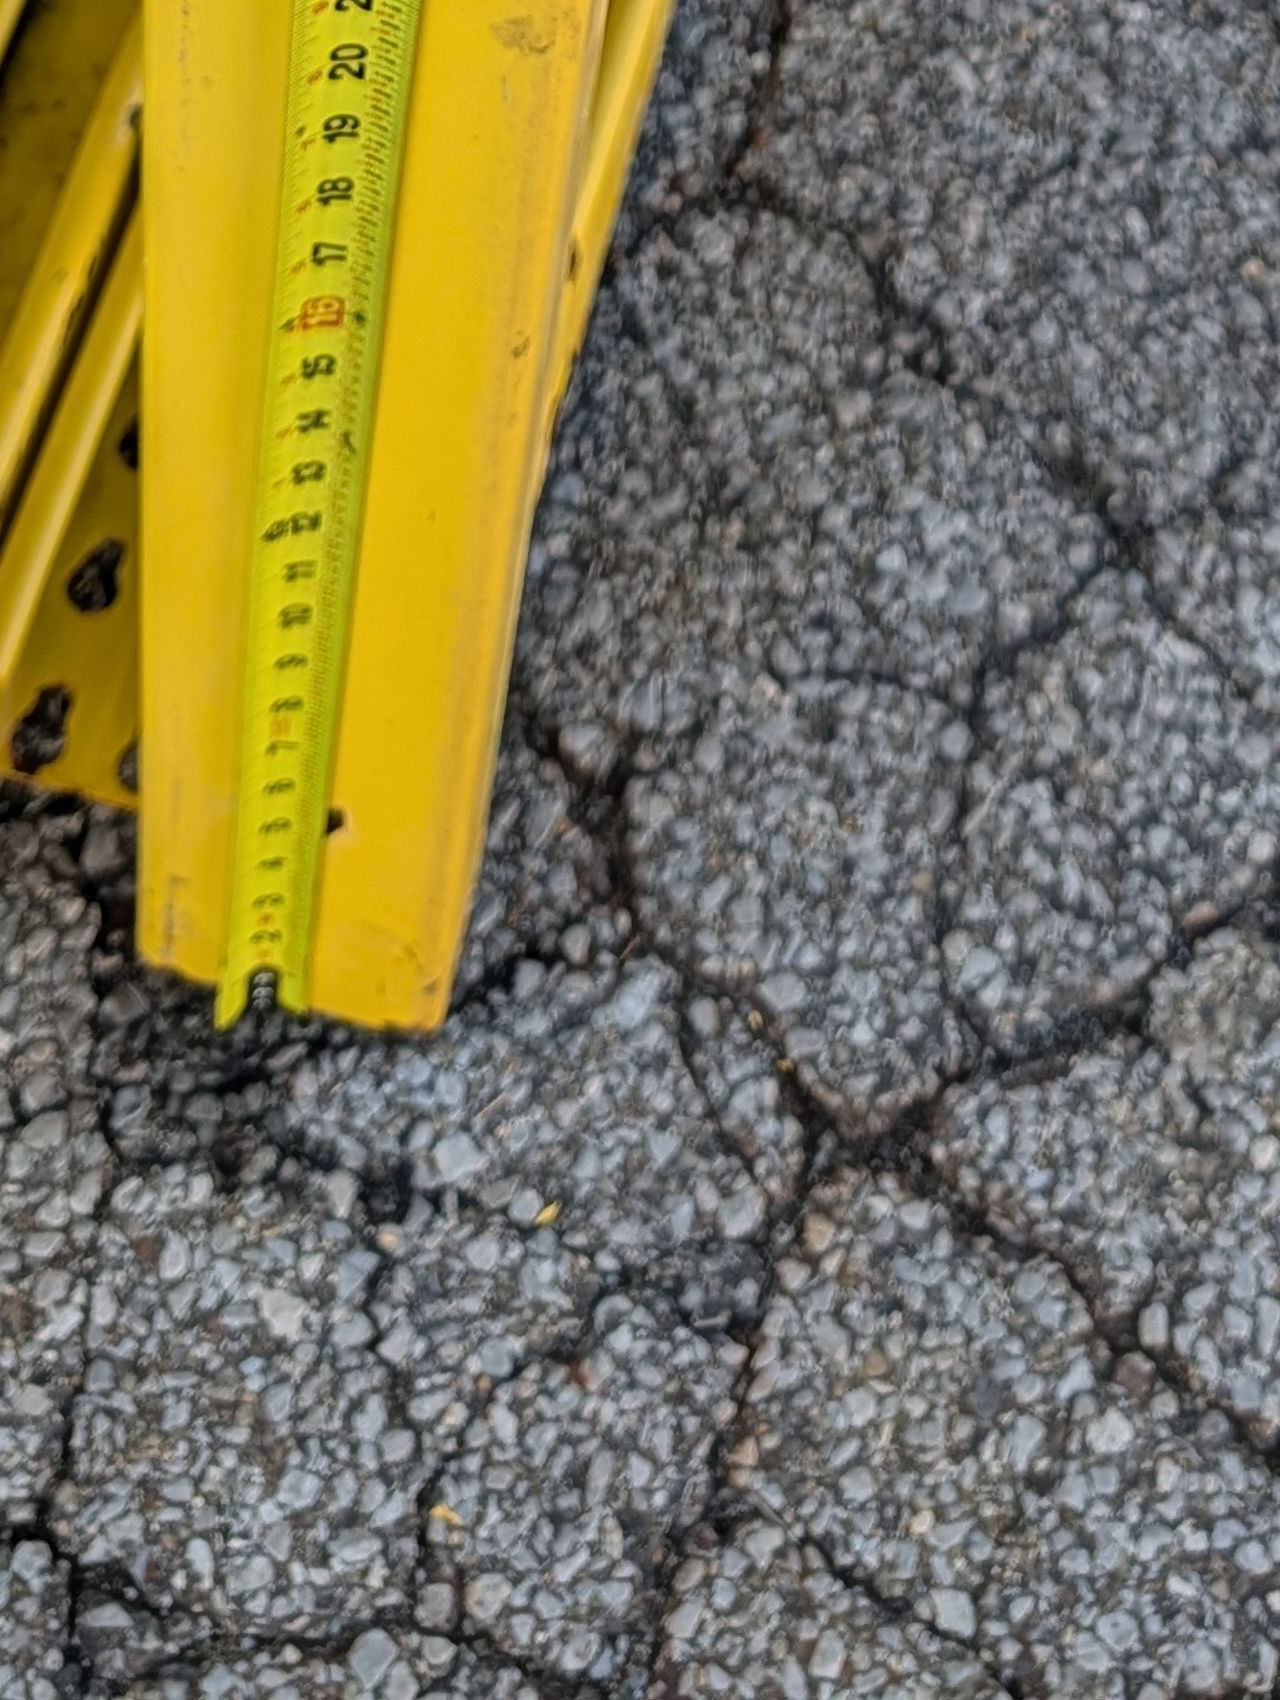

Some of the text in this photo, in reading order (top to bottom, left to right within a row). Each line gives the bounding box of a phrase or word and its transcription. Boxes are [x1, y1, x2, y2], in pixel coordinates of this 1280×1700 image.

[328, 43, 369, 80] 20
[322, 113, 361, 144] 19
[317, 177, 354, 207] 18
[311, 242, 348, 267] 17
